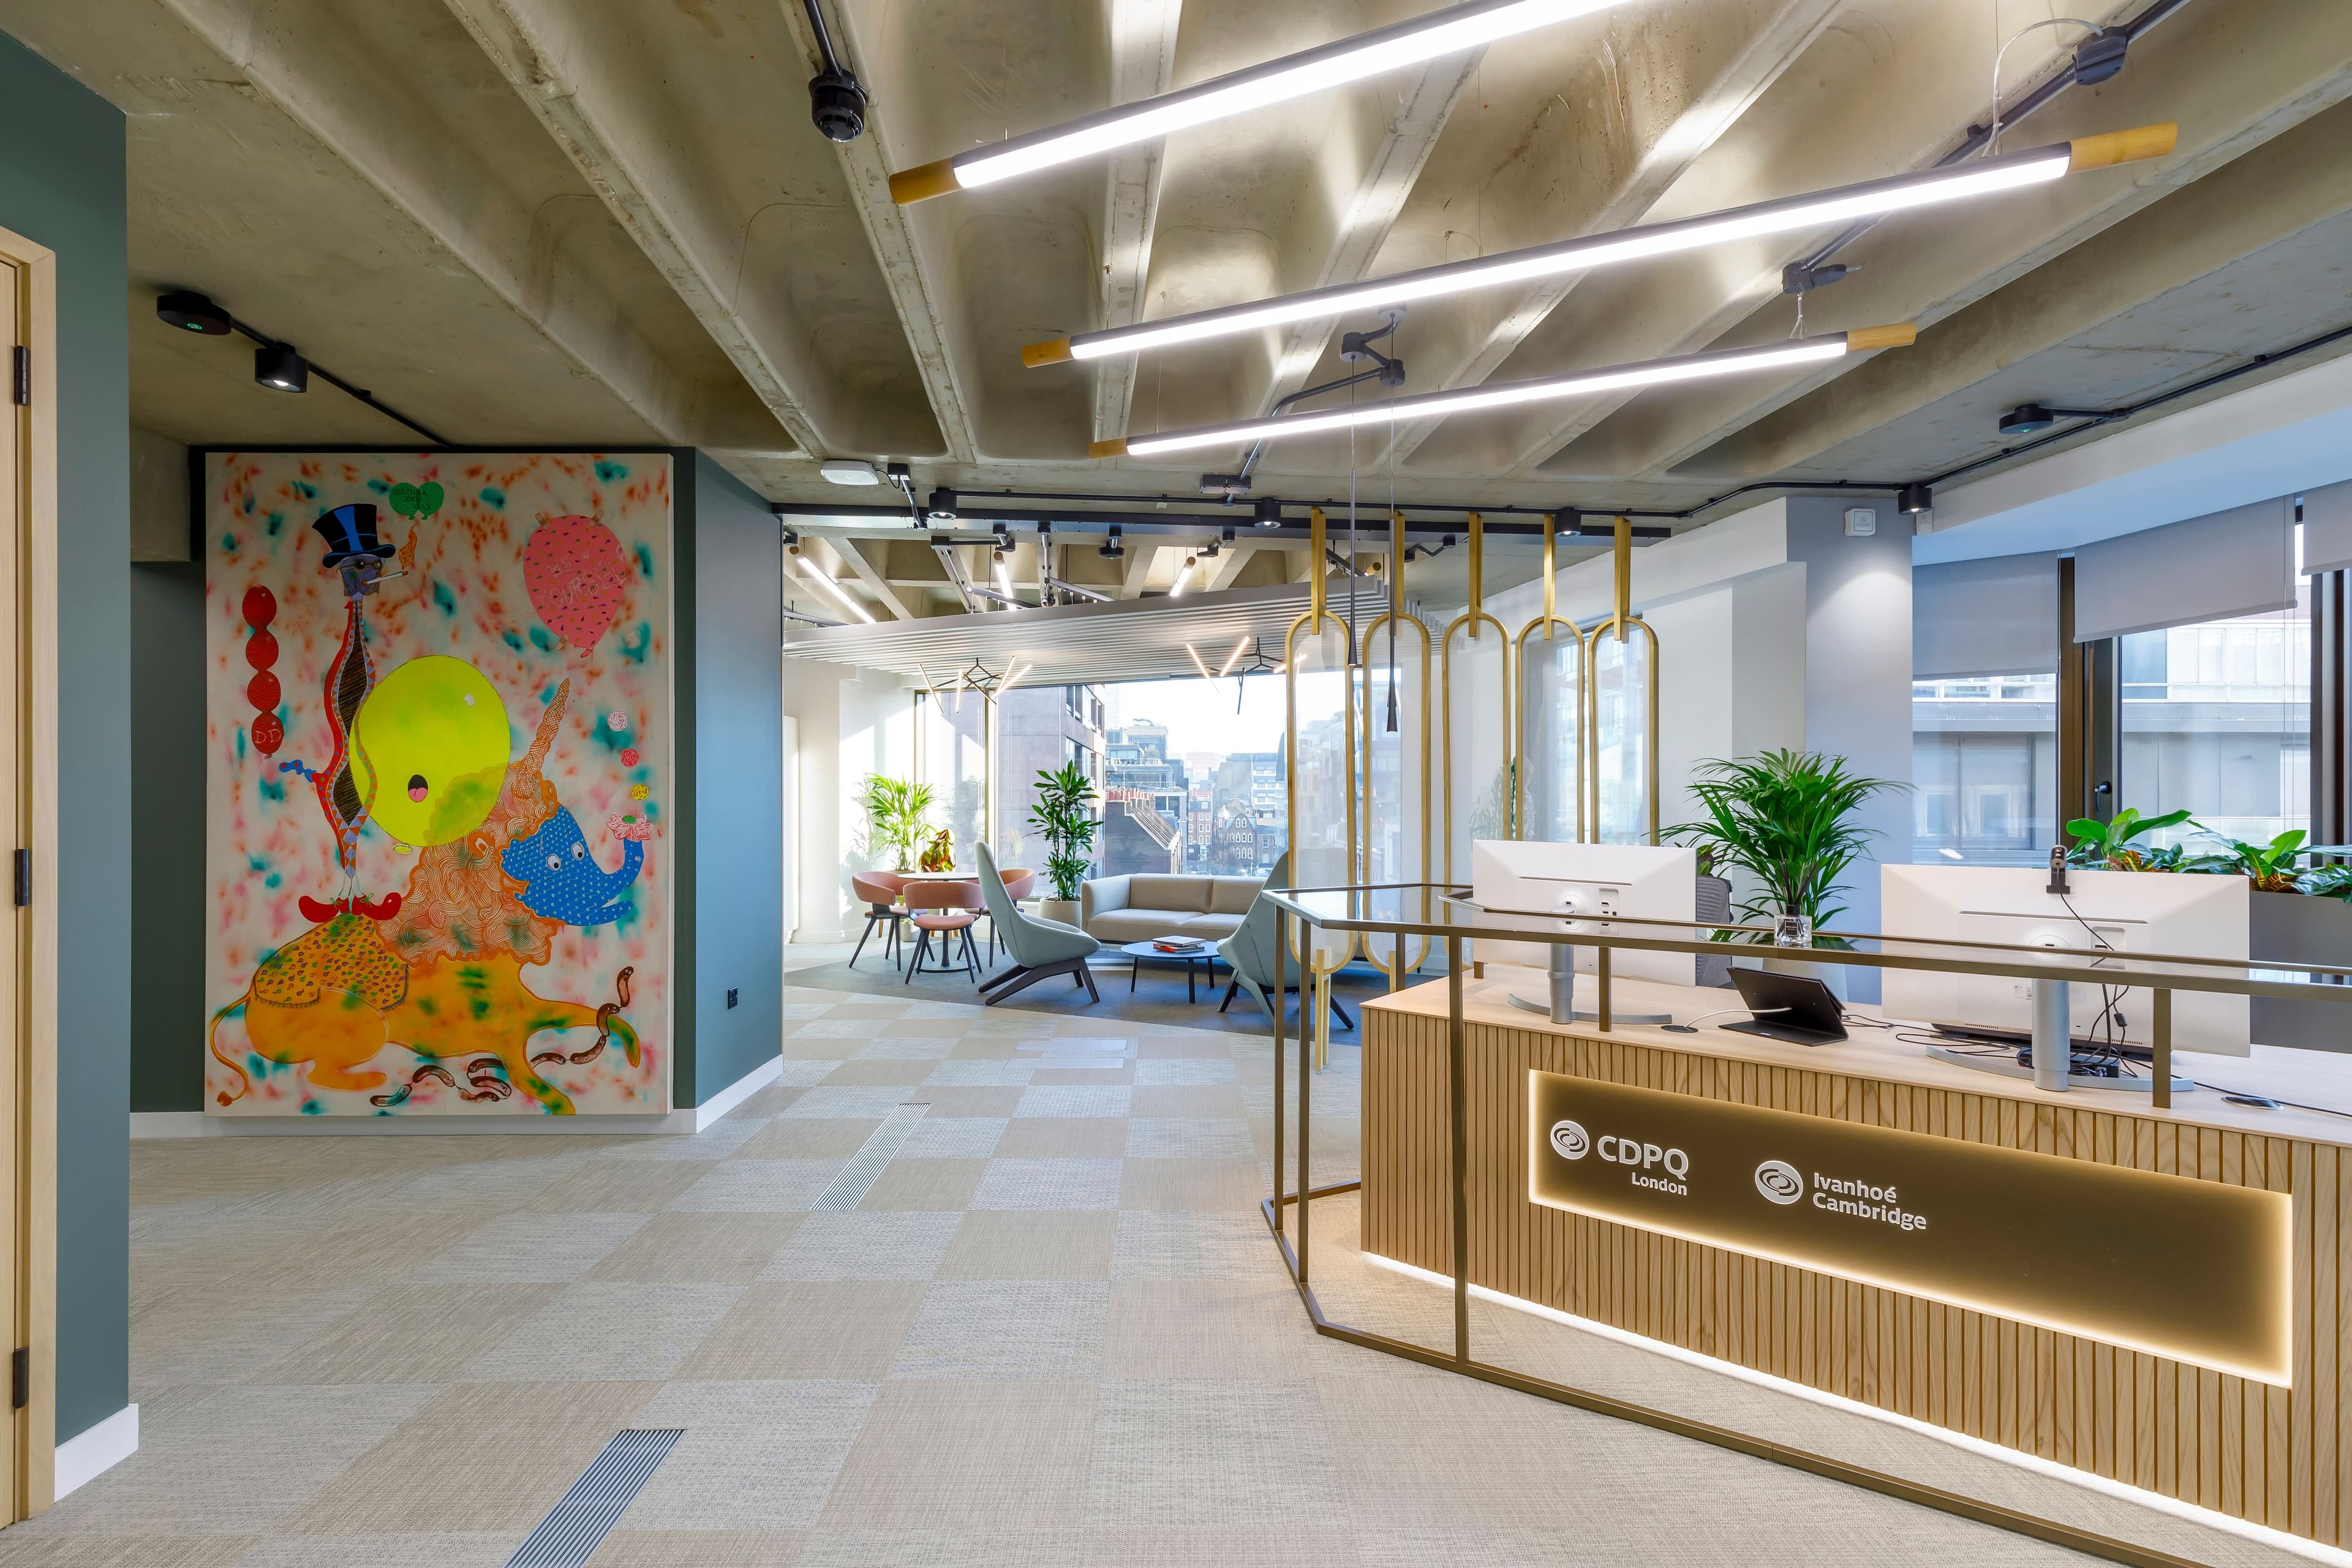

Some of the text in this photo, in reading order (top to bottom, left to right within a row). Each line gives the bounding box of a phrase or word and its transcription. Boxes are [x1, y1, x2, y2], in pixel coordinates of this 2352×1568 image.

[254, 728, 282, 744] DD
[1597, 1135, 1689, 1182] CDPQ
[1631, 1171, 1688, 1197] London
[1814, 1172, 1898, 1204] Ivanhoé
[1812, 1191, 1927, 1232] Cambridge
